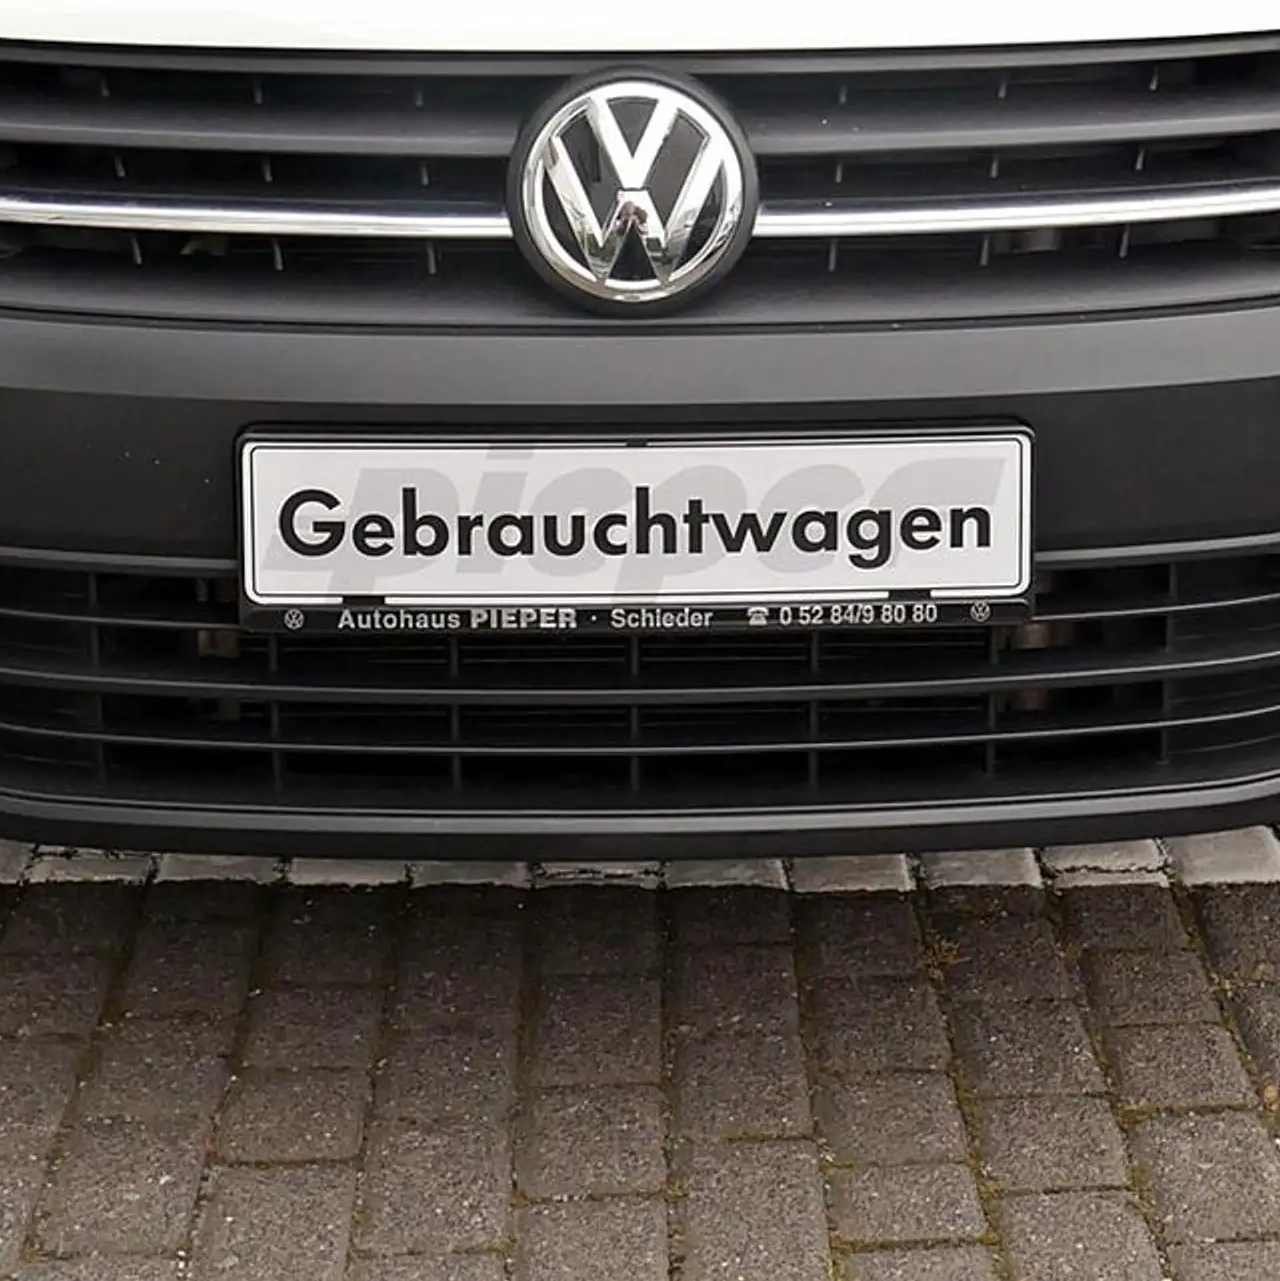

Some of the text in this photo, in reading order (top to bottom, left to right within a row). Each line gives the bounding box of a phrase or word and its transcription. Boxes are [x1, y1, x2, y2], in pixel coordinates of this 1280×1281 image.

[278, 486, 992, 569] Gebrauchtwagen
[337, 608, 461, 630] Autohaus
[470, 608, 578, 630] PIEPER
[610, 606, 714, 629] Schieder
